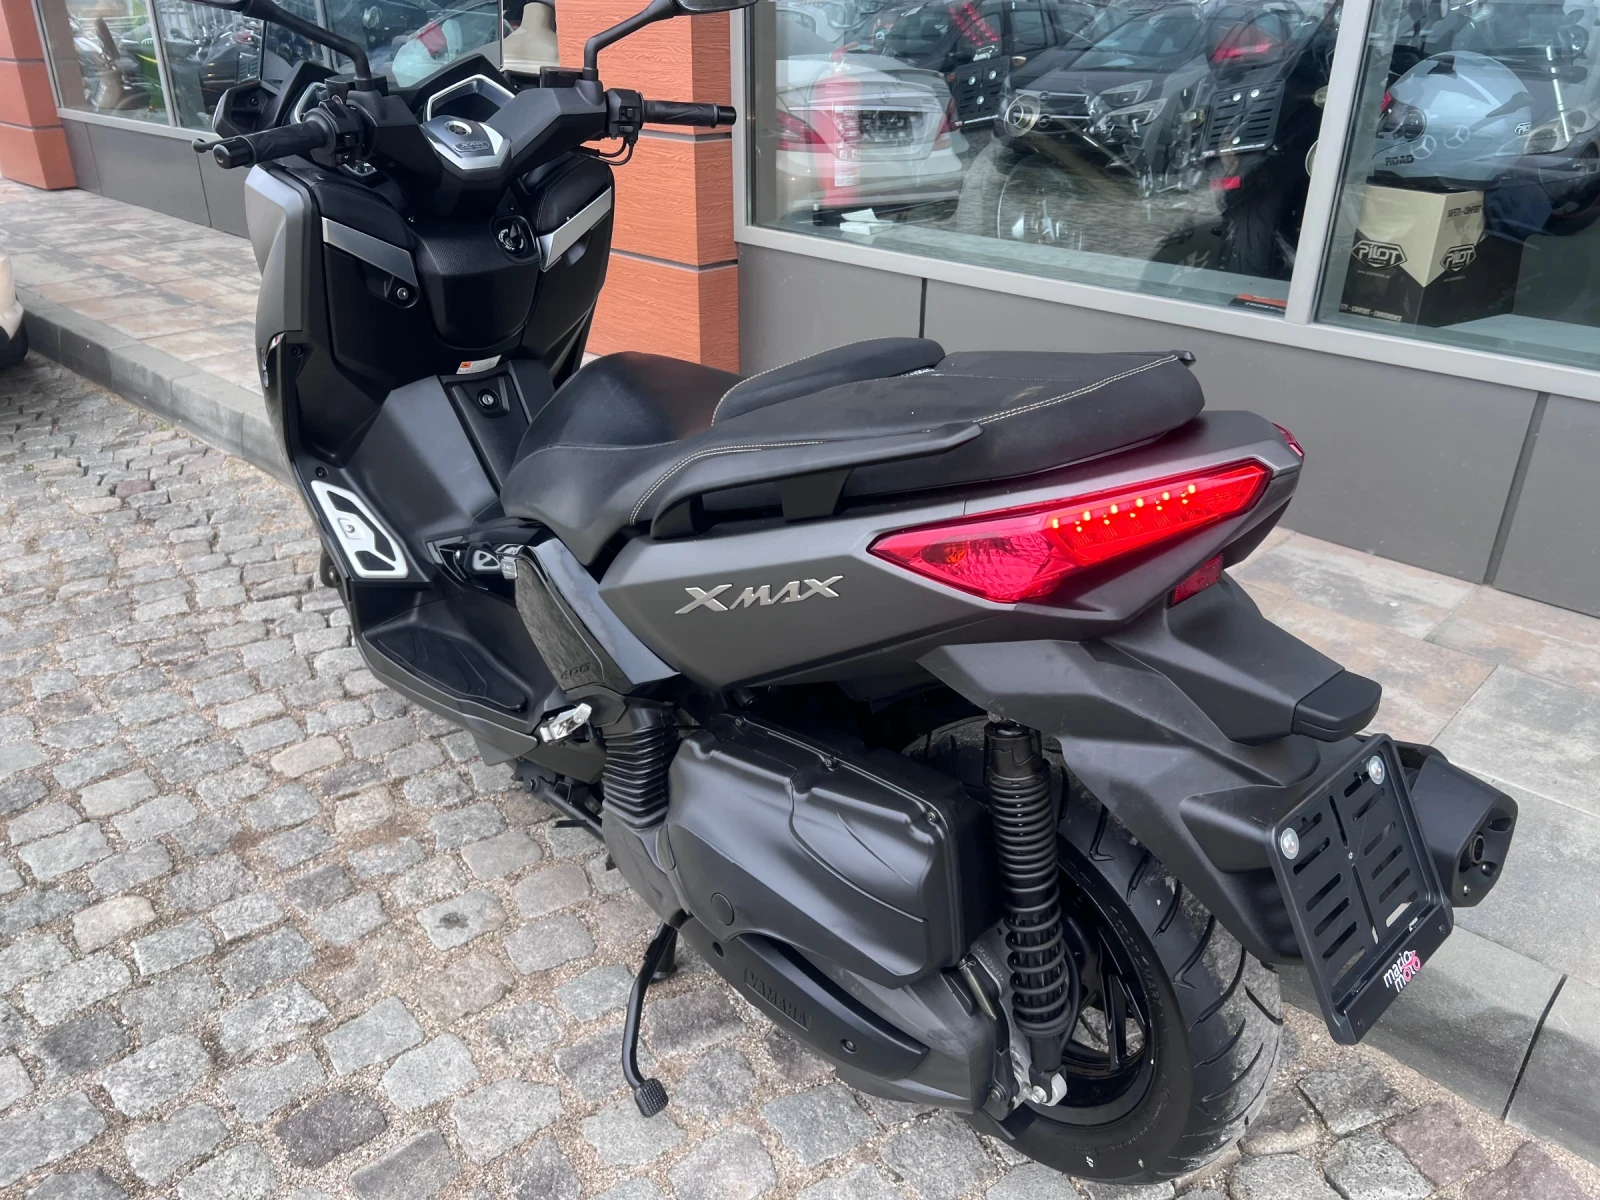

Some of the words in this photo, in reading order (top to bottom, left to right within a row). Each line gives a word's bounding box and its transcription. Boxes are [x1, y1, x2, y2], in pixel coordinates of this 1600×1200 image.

[1385, 154, 1415, 166] ROAD
[1358, 244, 1400, 265] PILOT
[1446, 249, 1474, 268] PILOT
[1383, 950, 1411, 988] mario
[1394, 956, 1421, 993] moto
[746, 970, 807, 1027] YAMAHA
